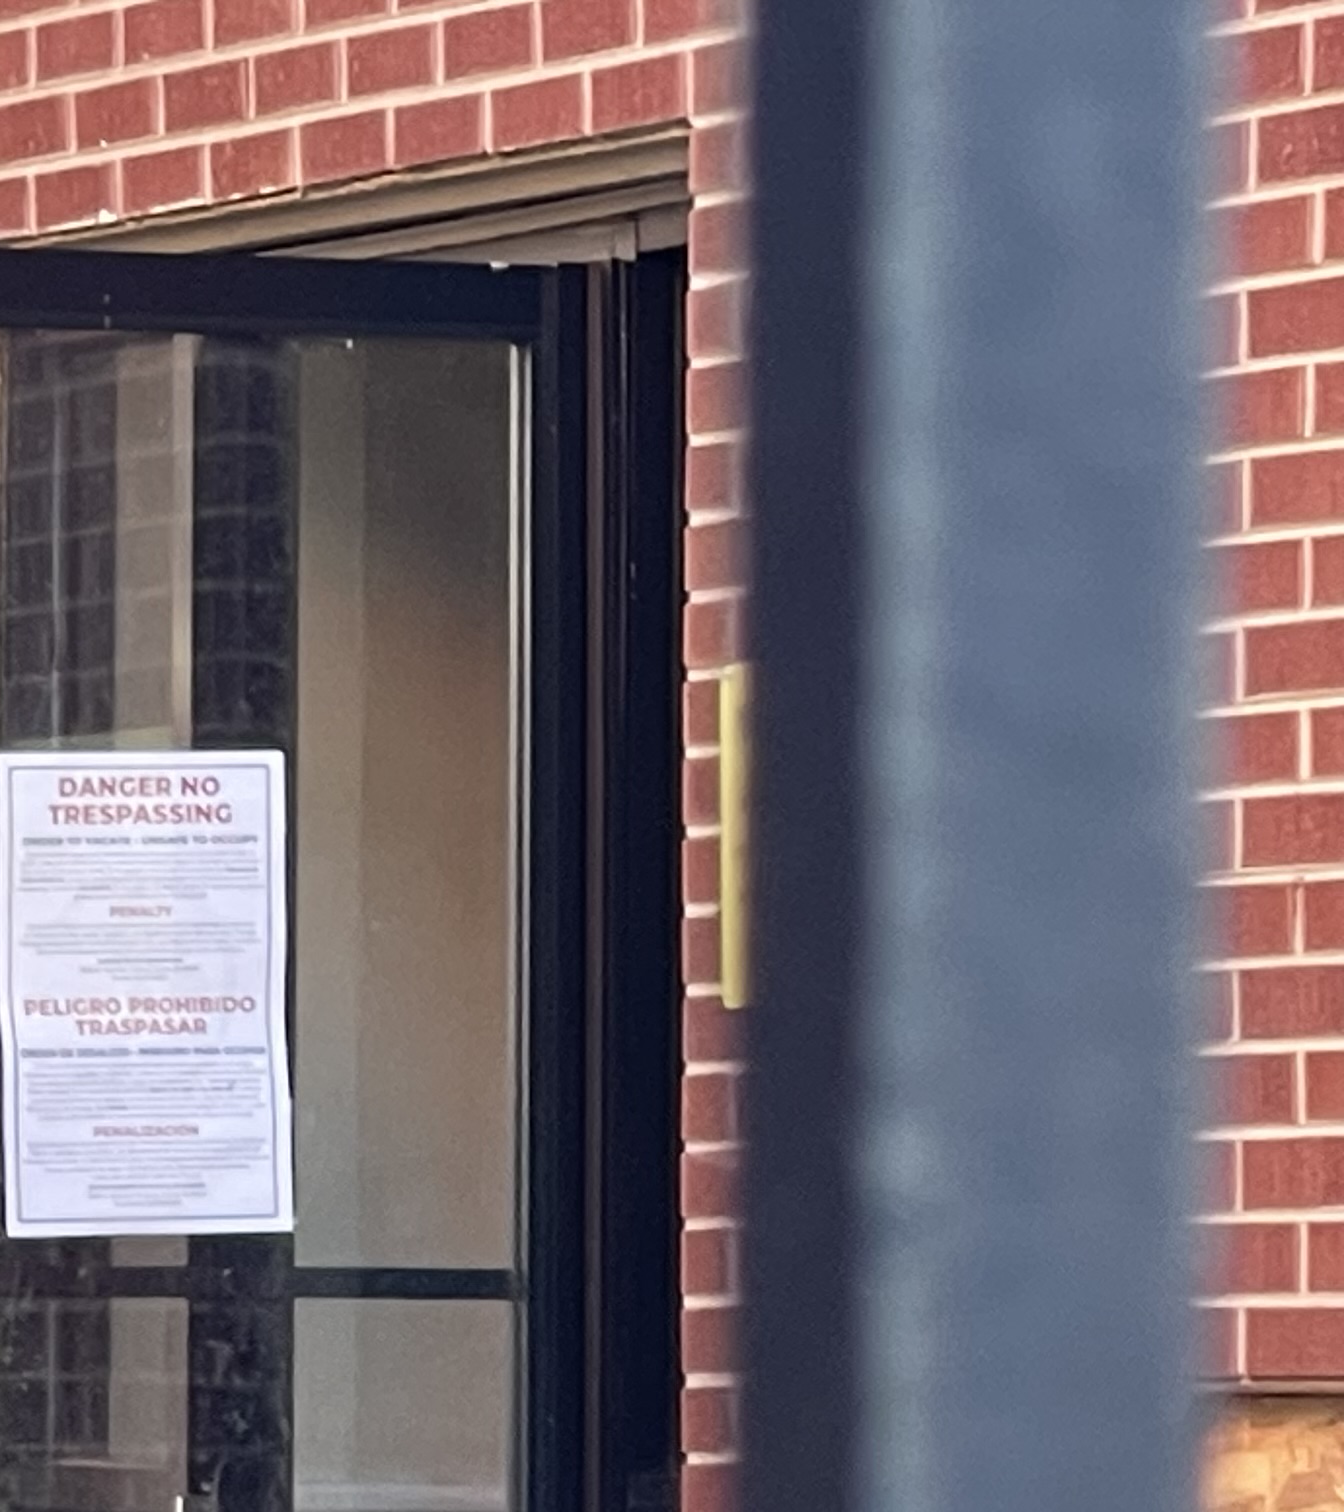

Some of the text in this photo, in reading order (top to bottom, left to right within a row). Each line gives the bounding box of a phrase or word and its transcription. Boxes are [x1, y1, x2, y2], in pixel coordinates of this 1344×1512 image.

[59, 776, 221, 797] DANGER NO
[49, 804, 233, 825] TRESPASSING
[109, 906, 172, 918] PENALTY
[23, 995, 257, 1016] PELIGRO PROHIBIDO
[75, 1018, 208, 1036] TRASPASAR
